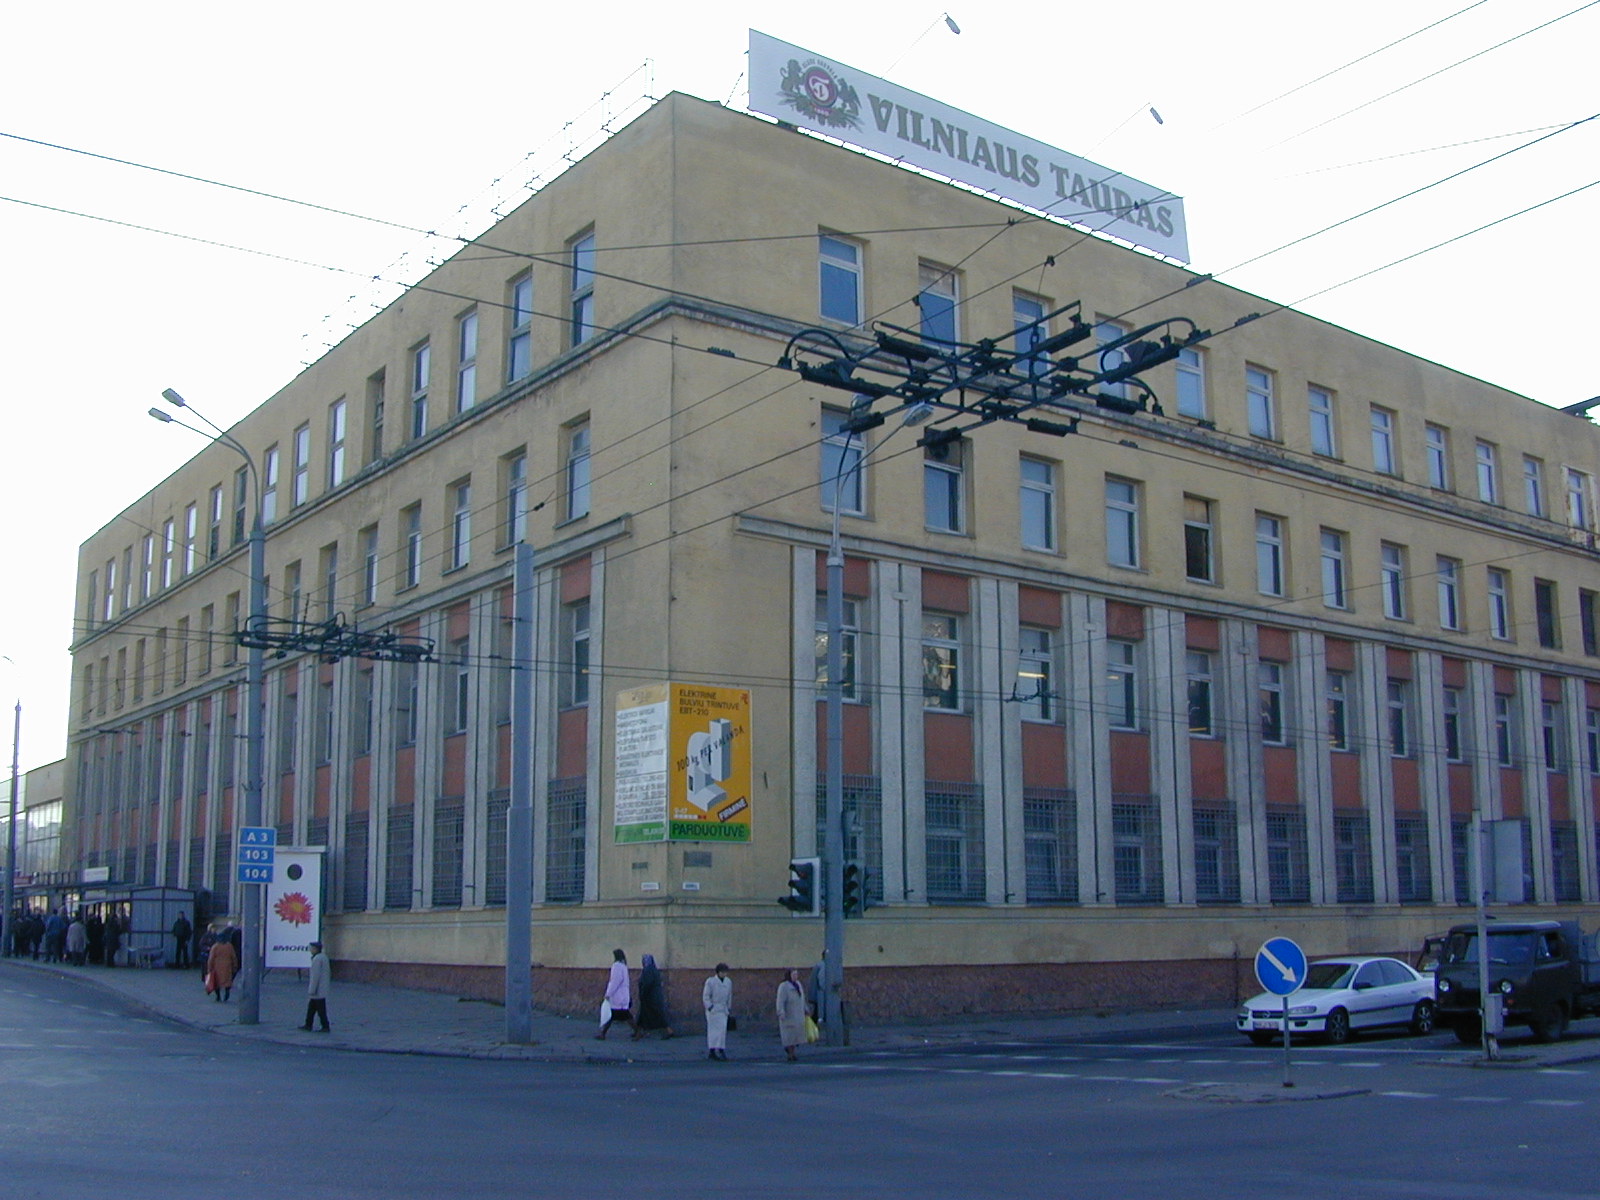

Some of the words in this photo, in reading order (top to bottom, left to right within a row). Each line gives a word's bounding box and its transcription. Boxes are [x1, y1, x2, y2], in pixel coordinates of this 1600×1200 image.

[866, 92, 1041, 188] VILNIAUS
[1050, 162, 1174, 238] TAURAS
[247, 832, 256, 842] A
[260, 832, 269, 842] 3
[245, 850, 269, 860] 103
[244, 868, 268, 878] 104
